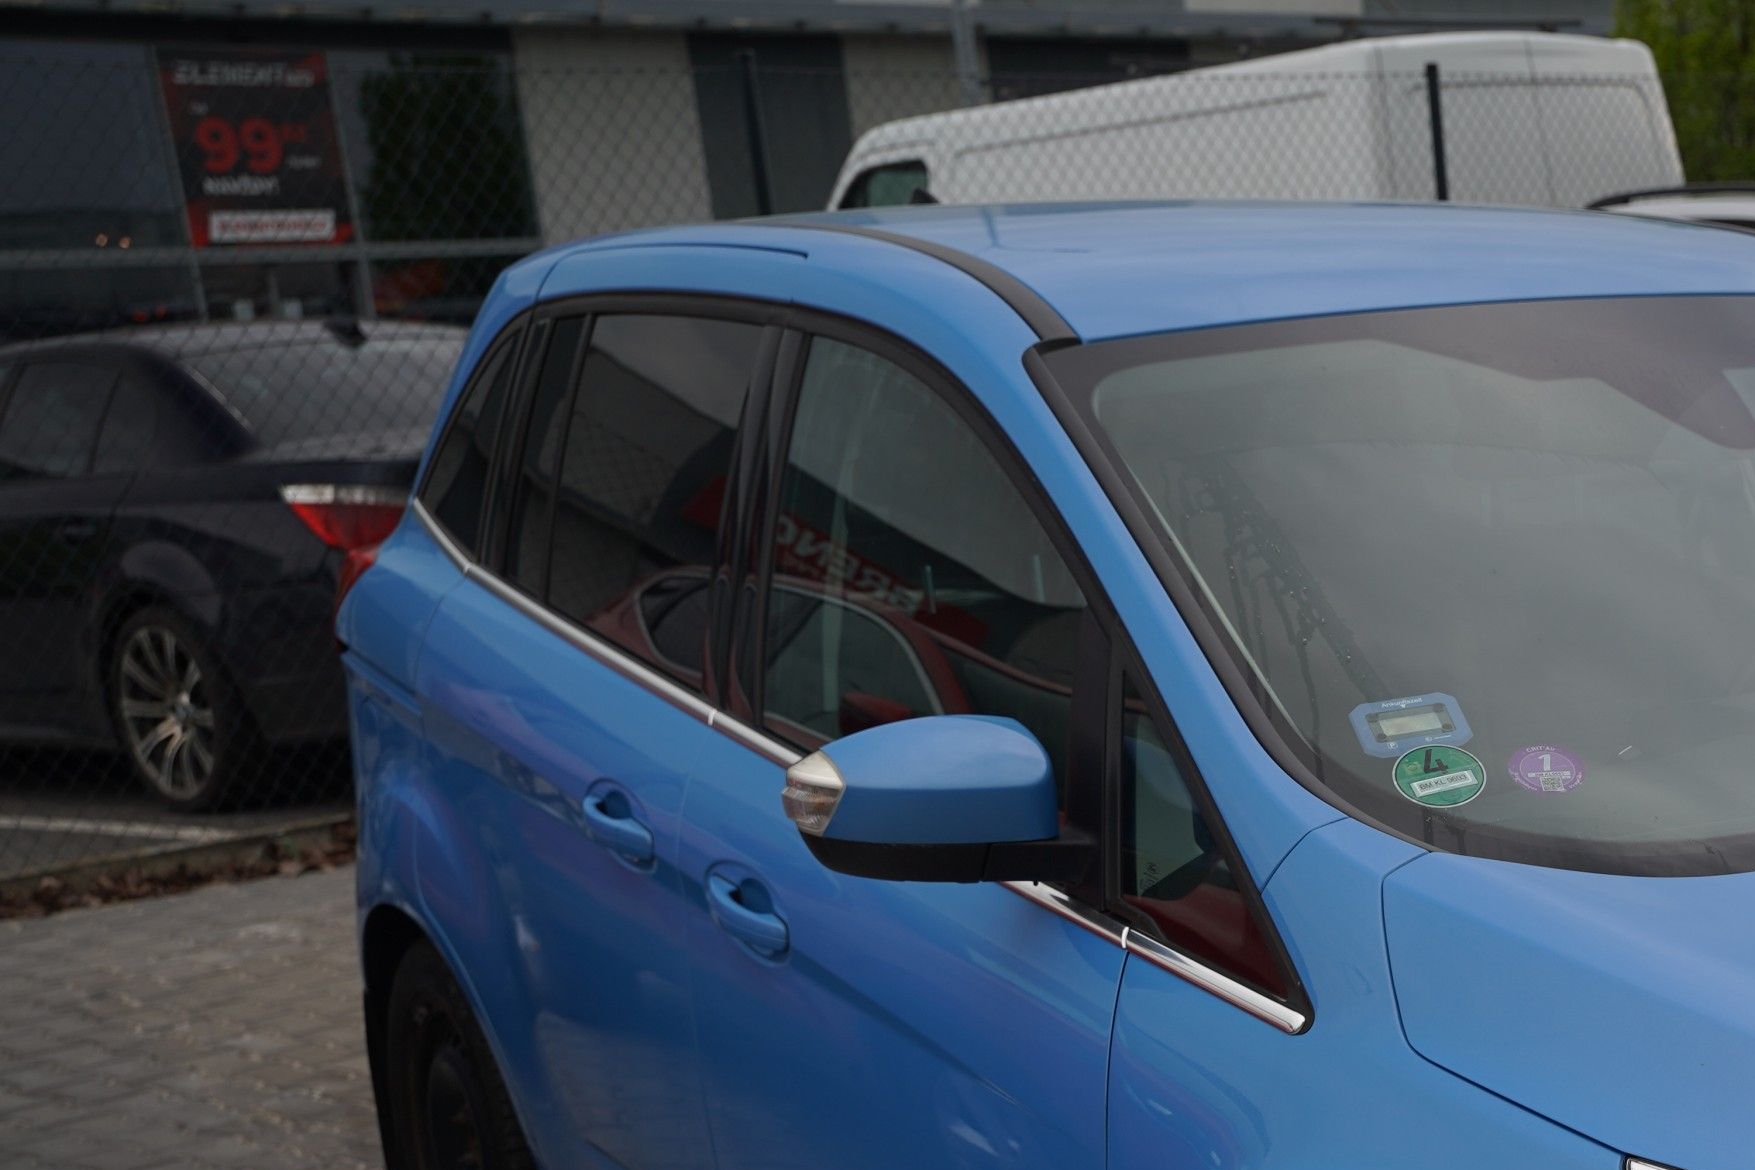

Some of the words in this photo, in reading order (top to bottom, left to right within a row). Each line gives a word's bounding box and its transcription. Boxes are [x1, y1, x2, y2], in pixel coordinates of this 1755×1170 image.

[195, 115, 282, 174] 99
[1423, 748, 1449, 773] 4
[1538, 753, 1551, 771] 1
